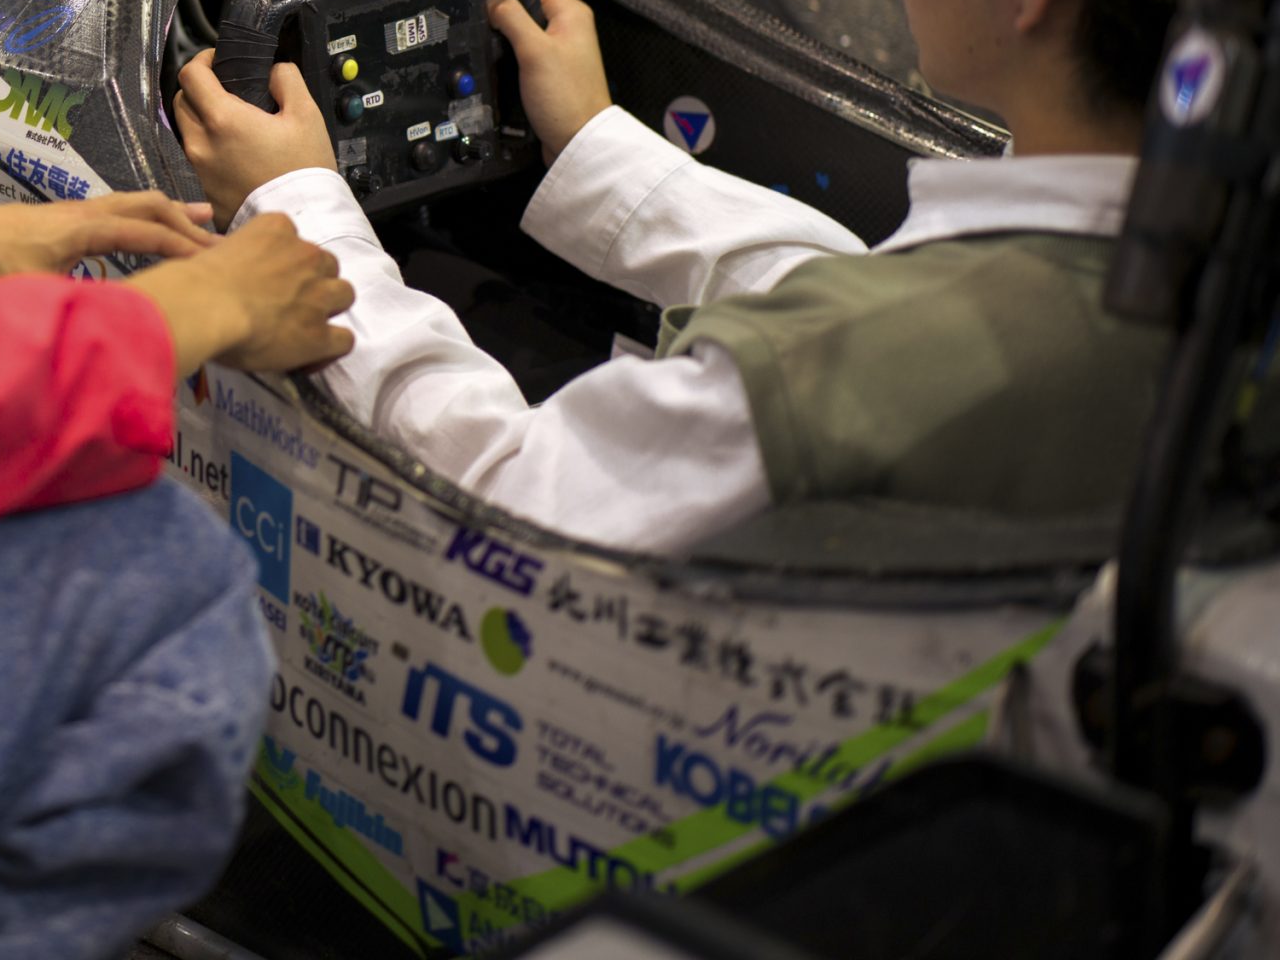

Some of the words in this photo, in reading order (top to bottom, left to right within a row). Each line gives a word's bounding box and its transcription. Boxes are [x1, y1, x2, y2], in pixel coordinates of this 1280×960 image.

[365, 94, 381, 107] RTD
[216, 379, 321, 469] MathWorks
[327, 534, 475, 643] KYOWA
[402, 660, 524, 768] ITS
[536, 719, 614, 772] TOTAL
